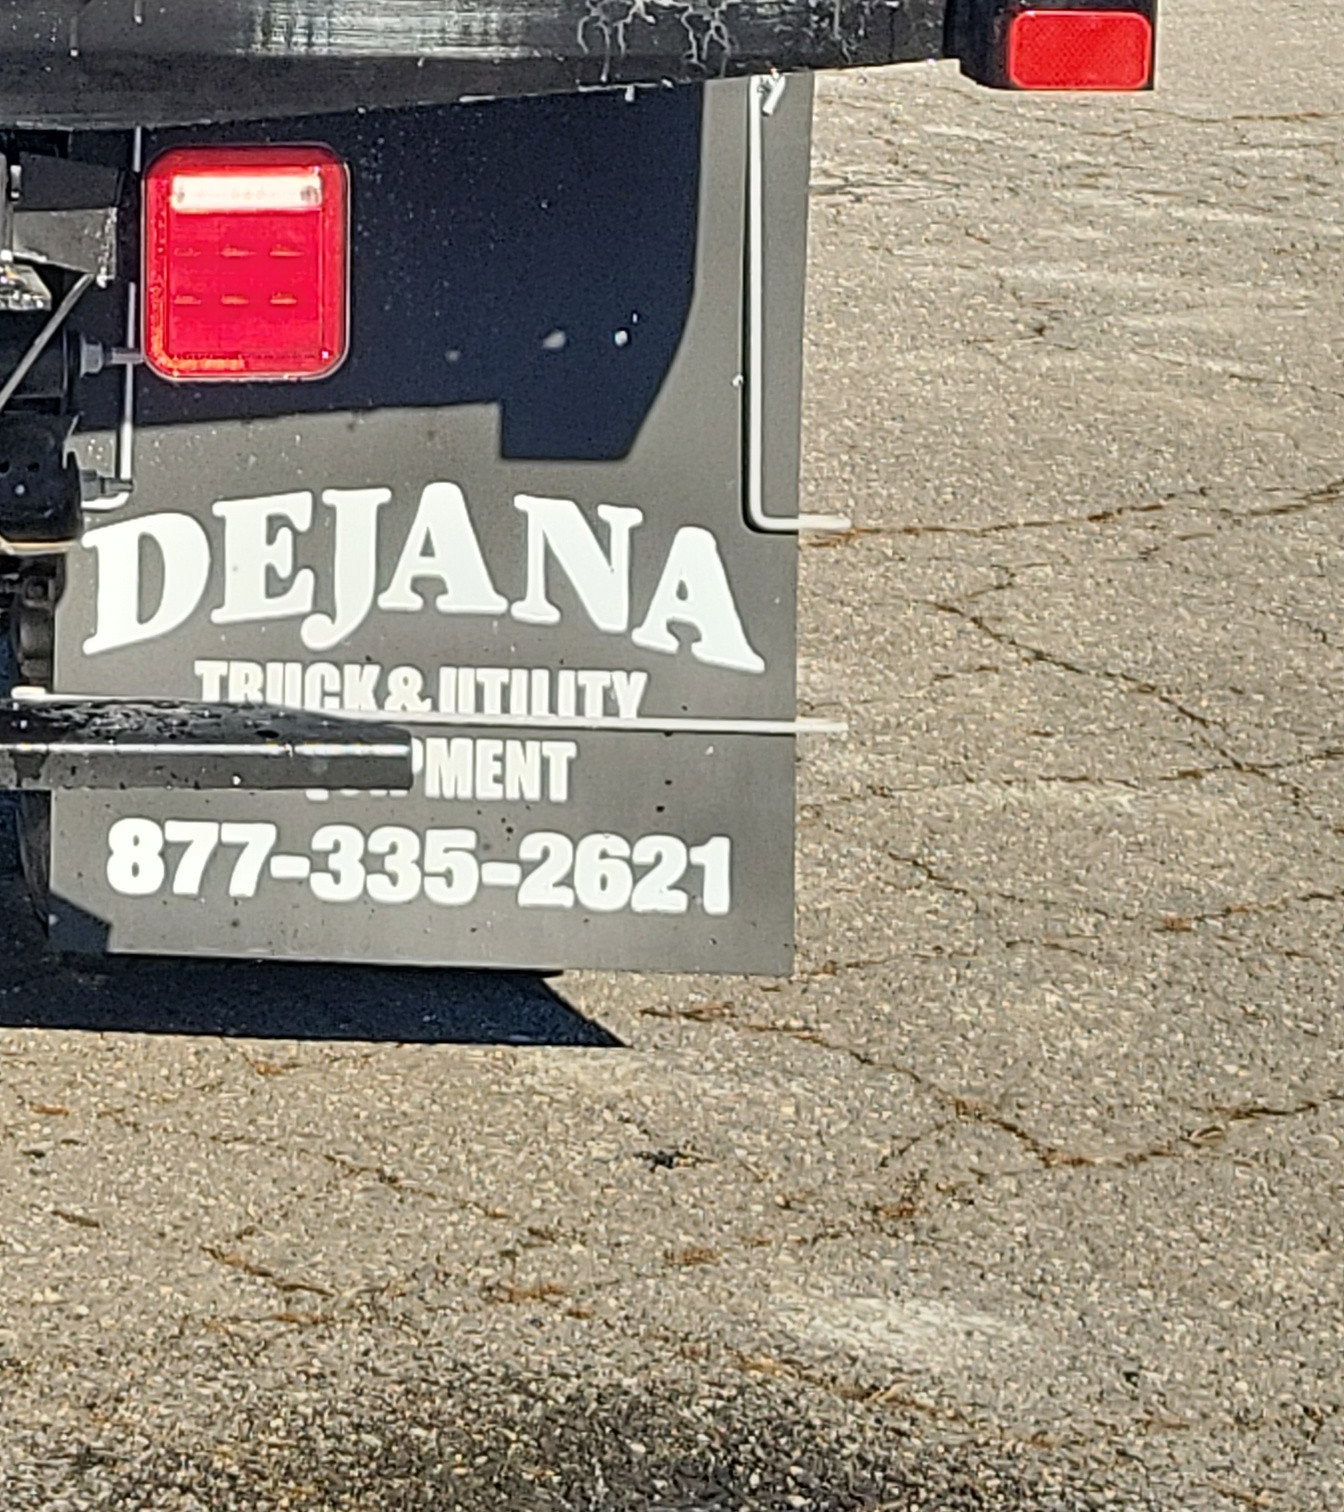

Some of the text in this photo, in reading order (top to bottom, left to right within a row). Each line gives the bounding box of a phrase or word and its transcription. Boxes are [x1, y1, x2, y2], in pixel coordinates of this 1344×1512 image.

[81, 481, 766, 674] DEJANA
[194, 660, 649, 719] TRUCK & UTILITY
[107, 816, 732, 916] 877-335-2621
